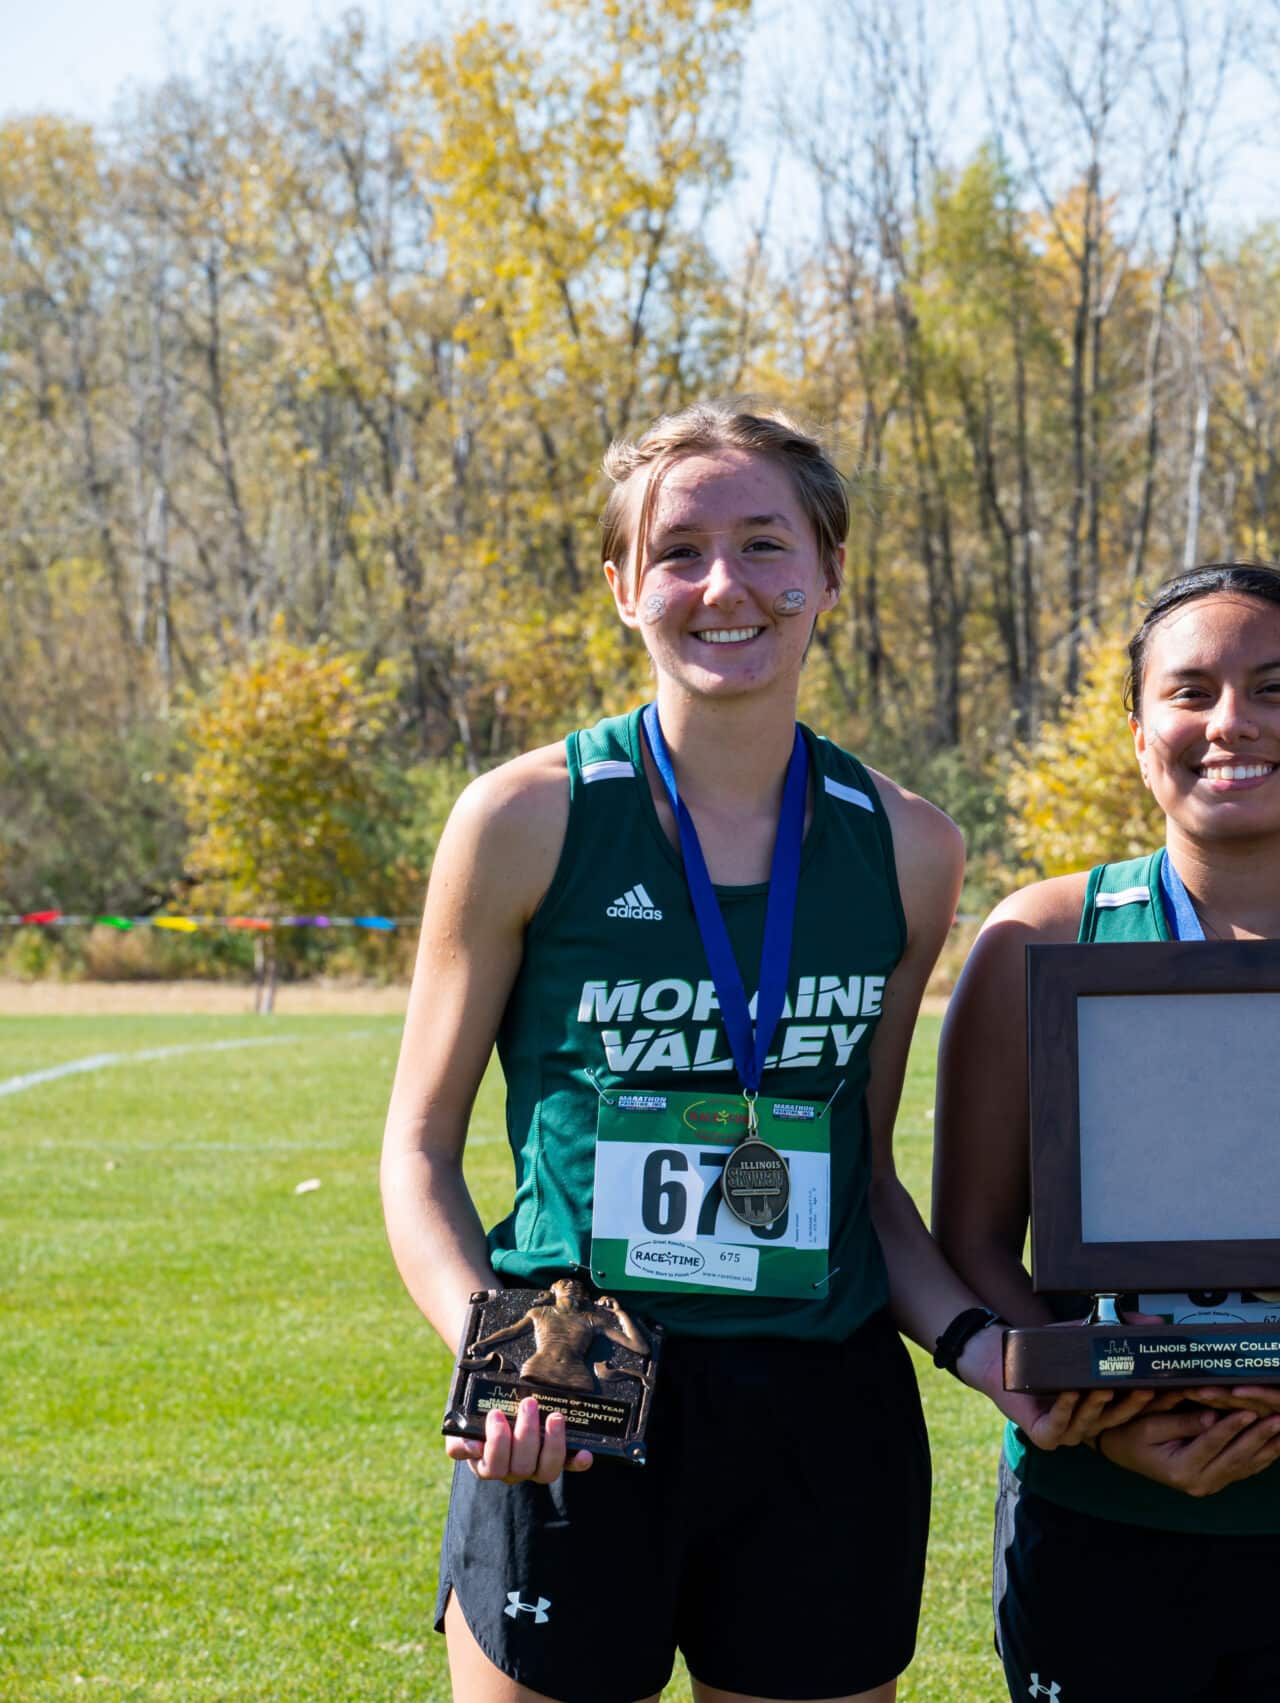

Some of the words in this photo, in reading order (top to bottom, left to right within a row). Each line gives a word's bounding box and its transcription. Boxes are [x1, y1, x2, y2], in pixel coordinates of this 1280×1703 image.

[606, 904, 663, 921] adidas
[601, 1023, 868, 1072] VALEY
[618, 1095, 667, 1104] MARATHON
[740, 1161, 781, 1170] ILLINOIS
[642, 1149, 790, 1240] 67
[635, 1250, 664, 1263] RACE
[672, 1255, 701, 1267] TIME
[719, 1251, 741, 1264] 675
[1139, 1342, 1187, 1354] ILLINOIS
[1189, 1341, 1238, 1353] SKYWAY
[1098, 1360, 1135, 1372] Skyway
[1151, 1358, 1233, 1370] CHAMPIONS
[537, 1404, 568, 1415] ROSS
[569, 1409, 624, 1424] COUNTRY
[581, 1401, 600, 1410] THE
[601, 1404, 625, 1414] YEAR
[564, 1415, 589, 1425] 022
